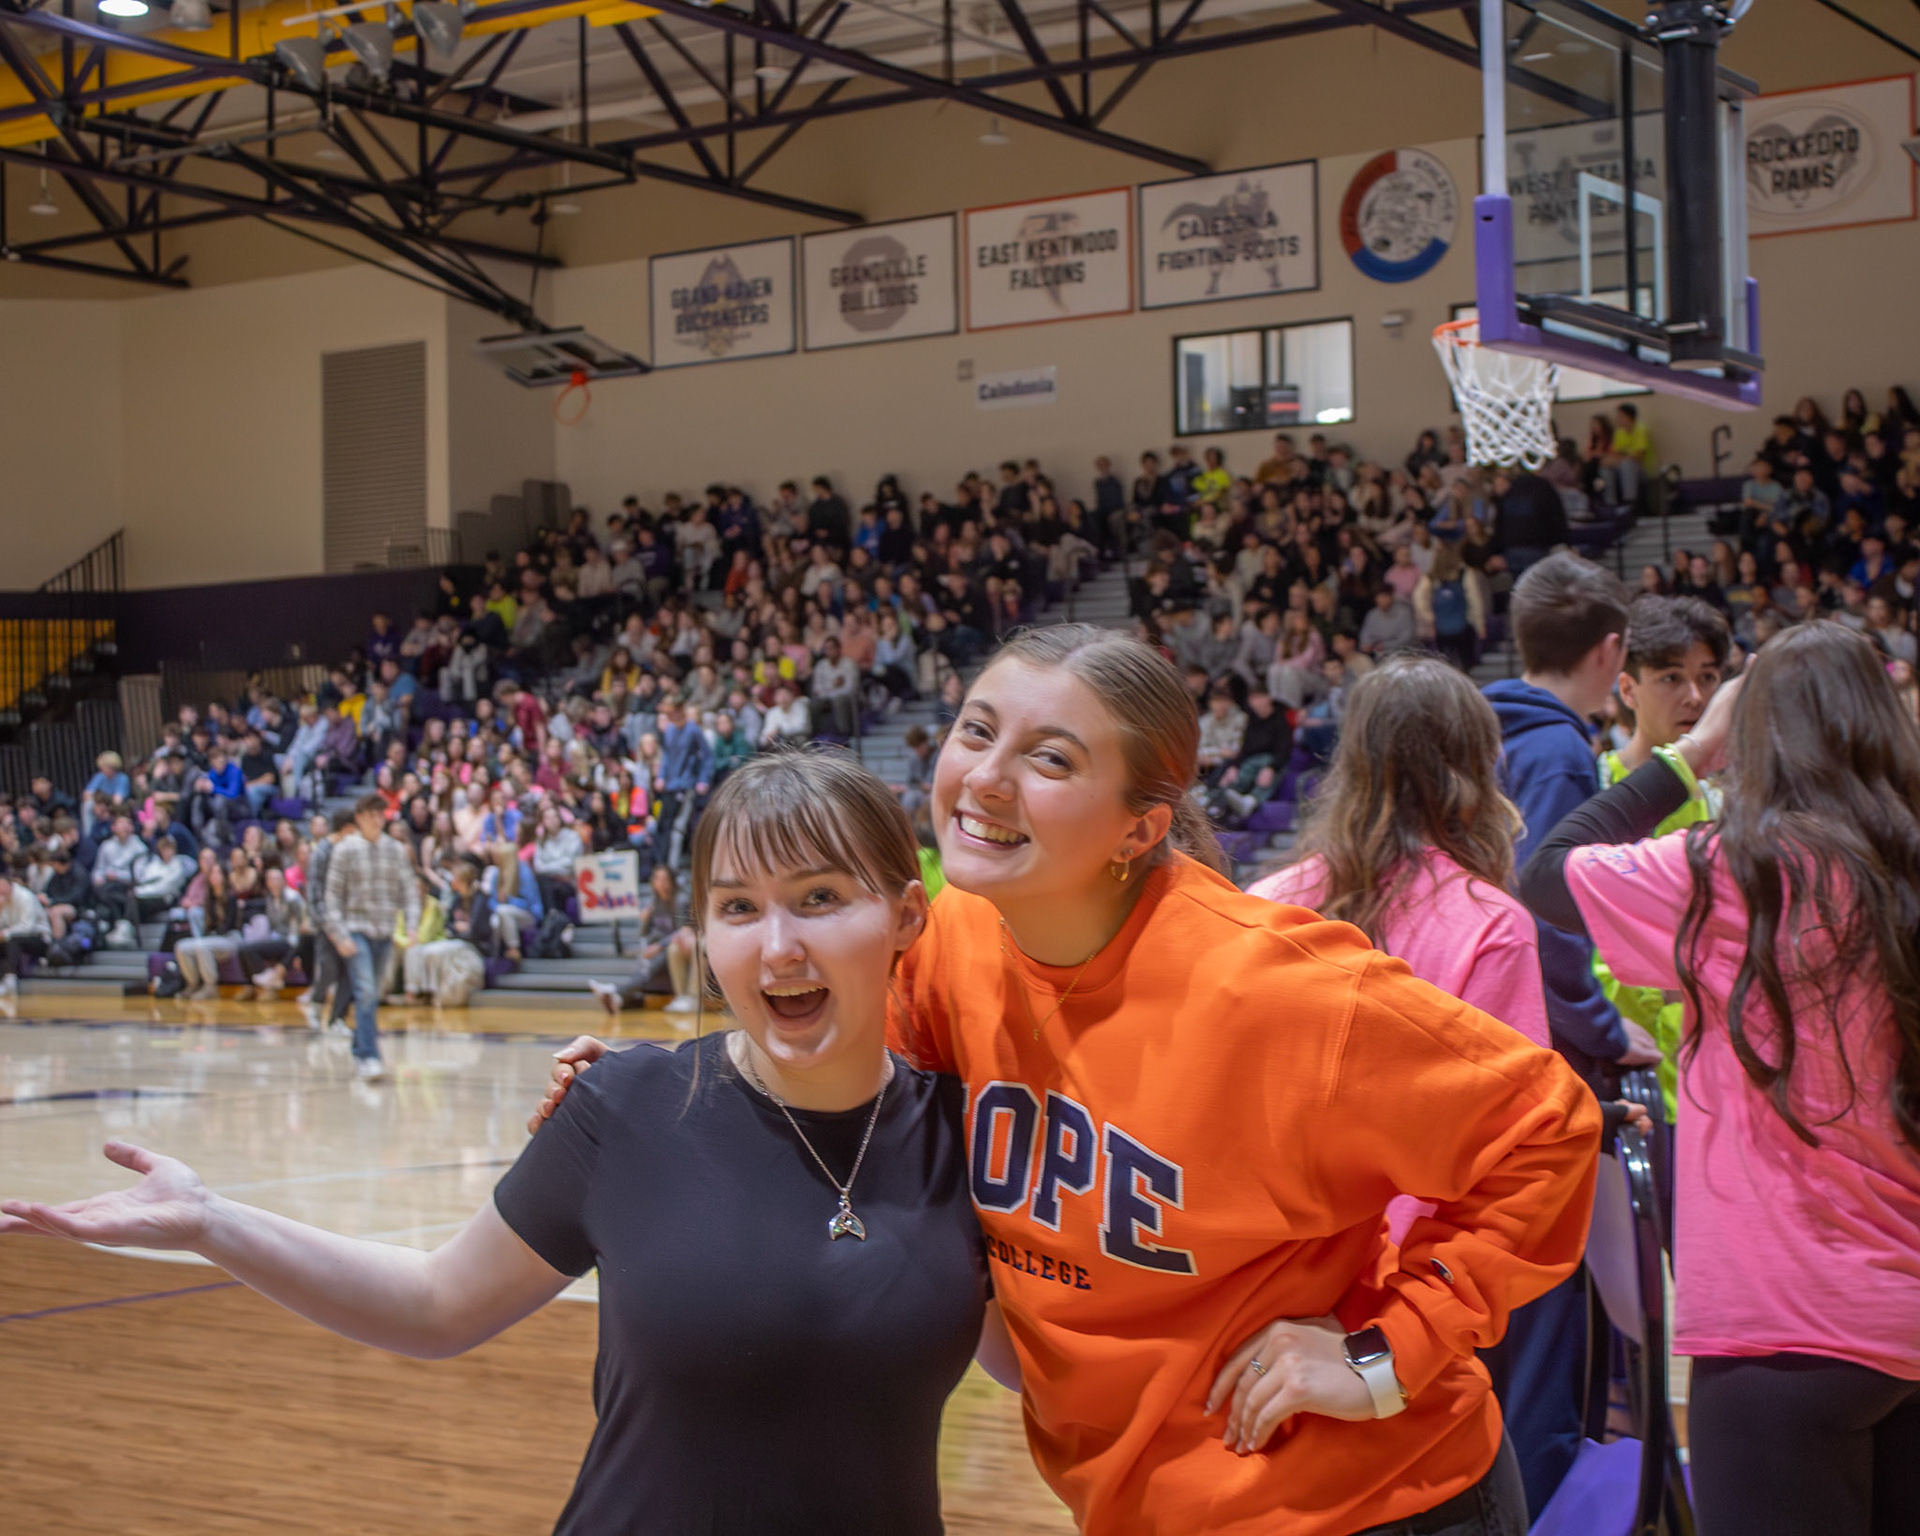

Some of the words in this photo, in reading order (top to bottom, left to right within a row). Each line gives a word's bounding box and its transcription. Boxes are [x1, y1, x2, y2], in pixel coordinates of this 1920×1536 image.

[1747, 128, 1859, 164] ROCKFORD
[1772, 163, 1836, 194] RAMS
[1178, 210, 1277, 241] CALEDONA
[978, 240, 1020, 268] EAST
[1025, 229, 1119, 260] KENTWOOD
[1157, 244, 1236, 273] FIGHTING
[1243, 235, 1301, 261] SCOTS
[1010, 262, 1086, 290] FALCONS
[671, 284, 718, 310] GRAND
[724, 277, 773, 301] HAVEN
[840, 284, 919, 313] BULLDOGS
[676, 304, 770, 334] BUCCANEERS
[963, 1080, 1199, 1276] OPE
[986, 1233, 1093, 1292] COLLEGE
